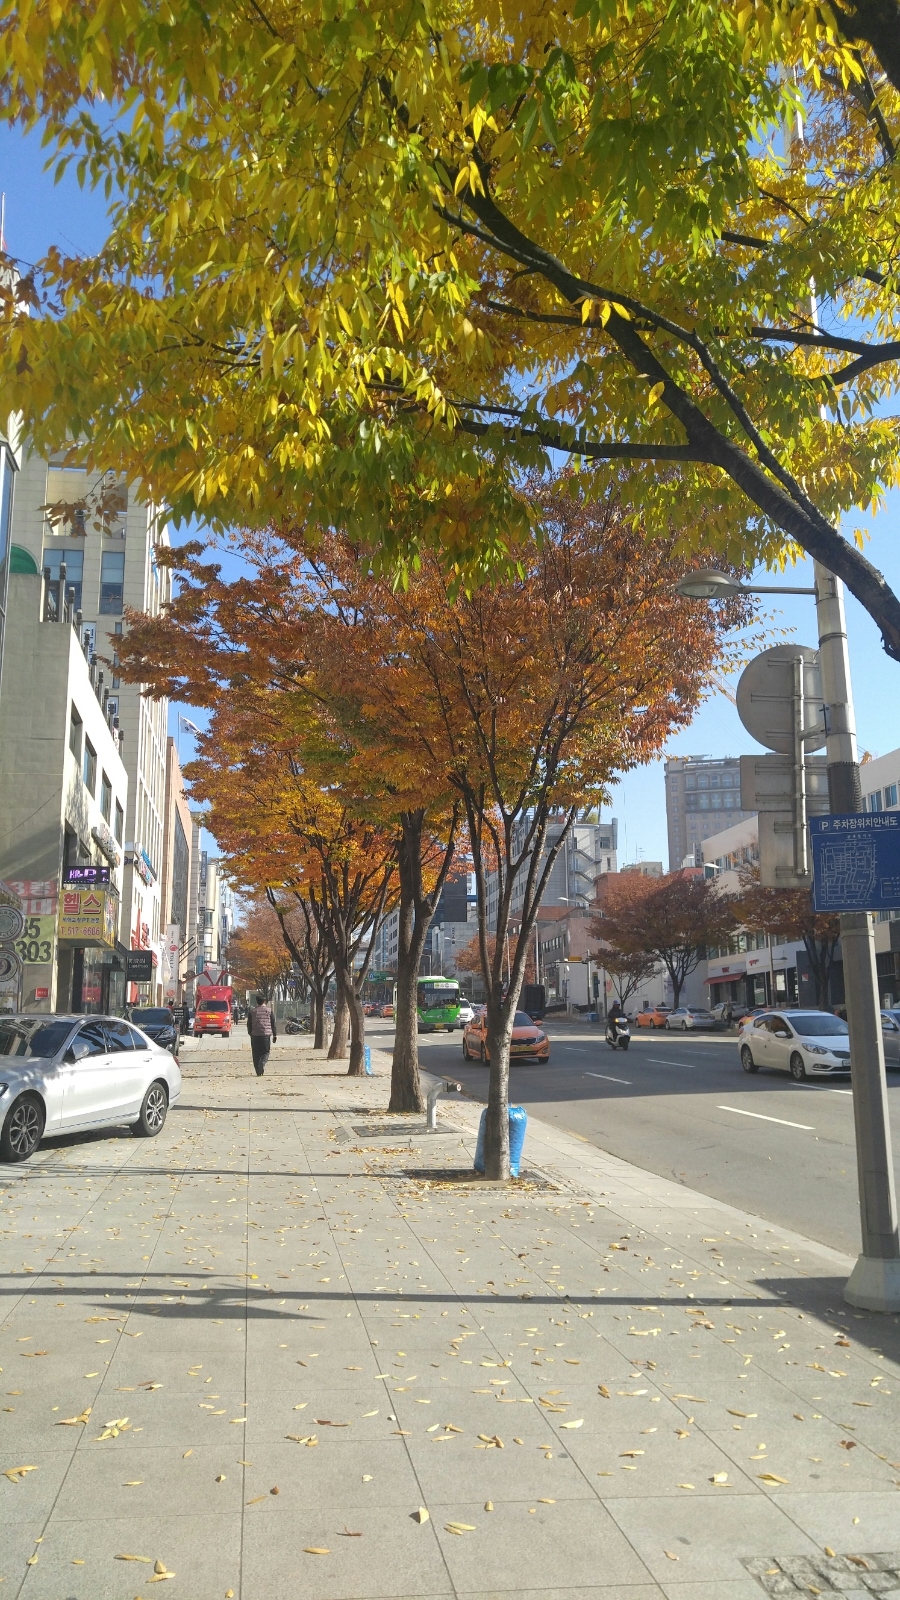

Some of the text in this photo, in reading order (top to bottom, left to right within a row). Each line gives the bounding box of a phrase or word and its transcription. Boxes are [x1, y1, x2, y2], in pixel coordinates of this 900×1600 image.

[821, 816, 898, 830] P 주차장위치안내도
[63, 892, 101, 915] 헬스
